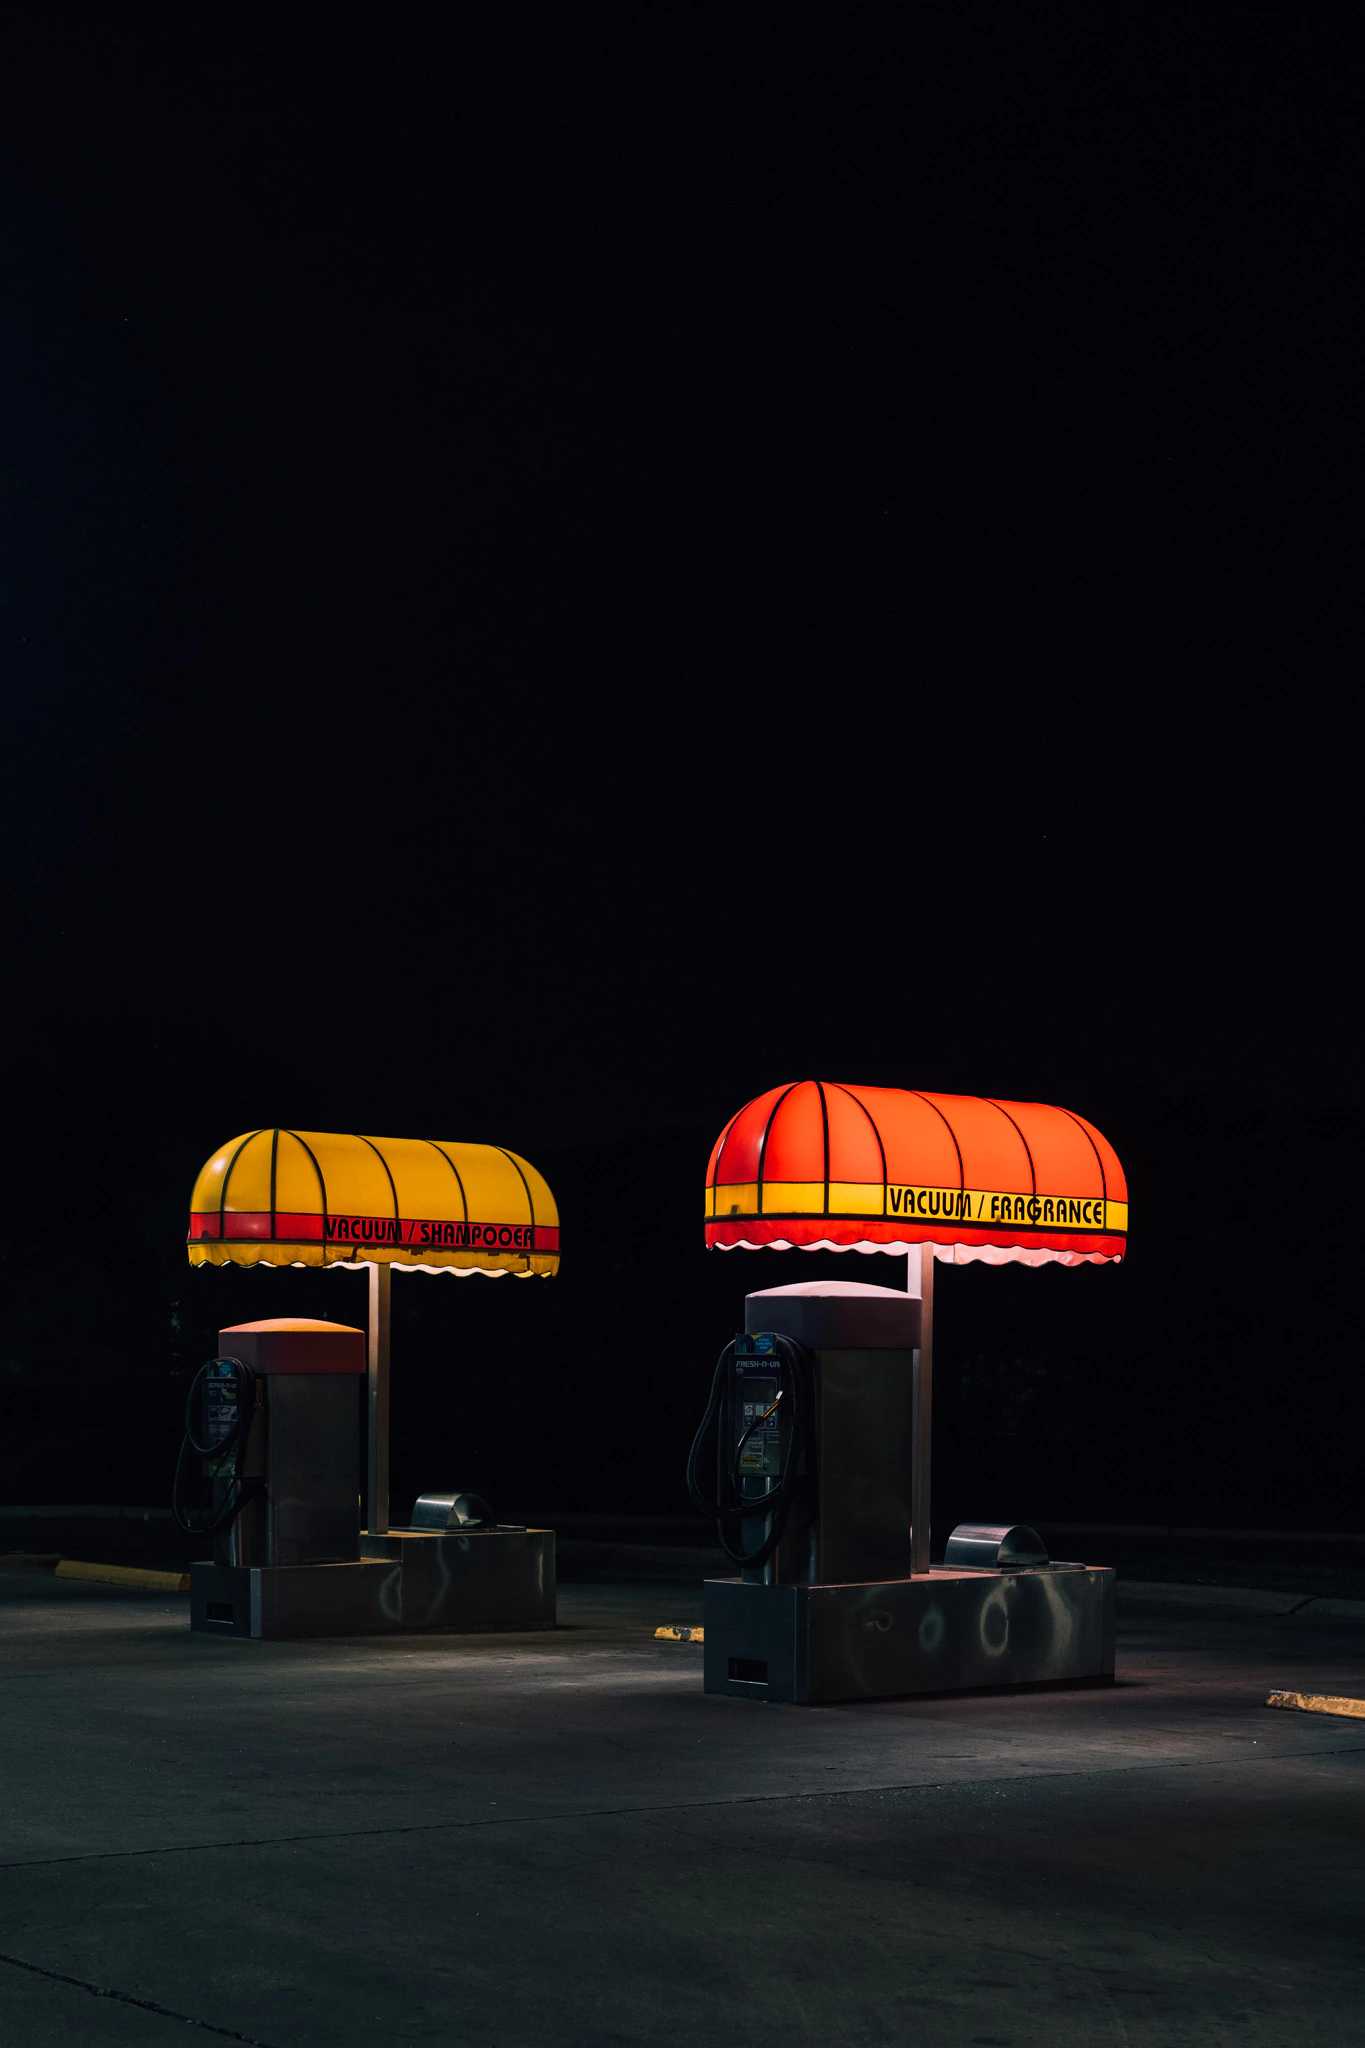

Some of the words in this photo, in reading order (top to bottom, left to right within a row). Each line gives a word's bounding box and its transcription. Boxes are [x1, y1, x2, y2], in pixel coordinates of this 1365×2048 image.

[890, 1188, 972, 1218] VACUUM
[990, 1196, 1102, 1225] FRAGRANCE
[325, 1217, 403, 1241] VACUUM
[420, 1223, 534, 1249] SHAMPOOER
